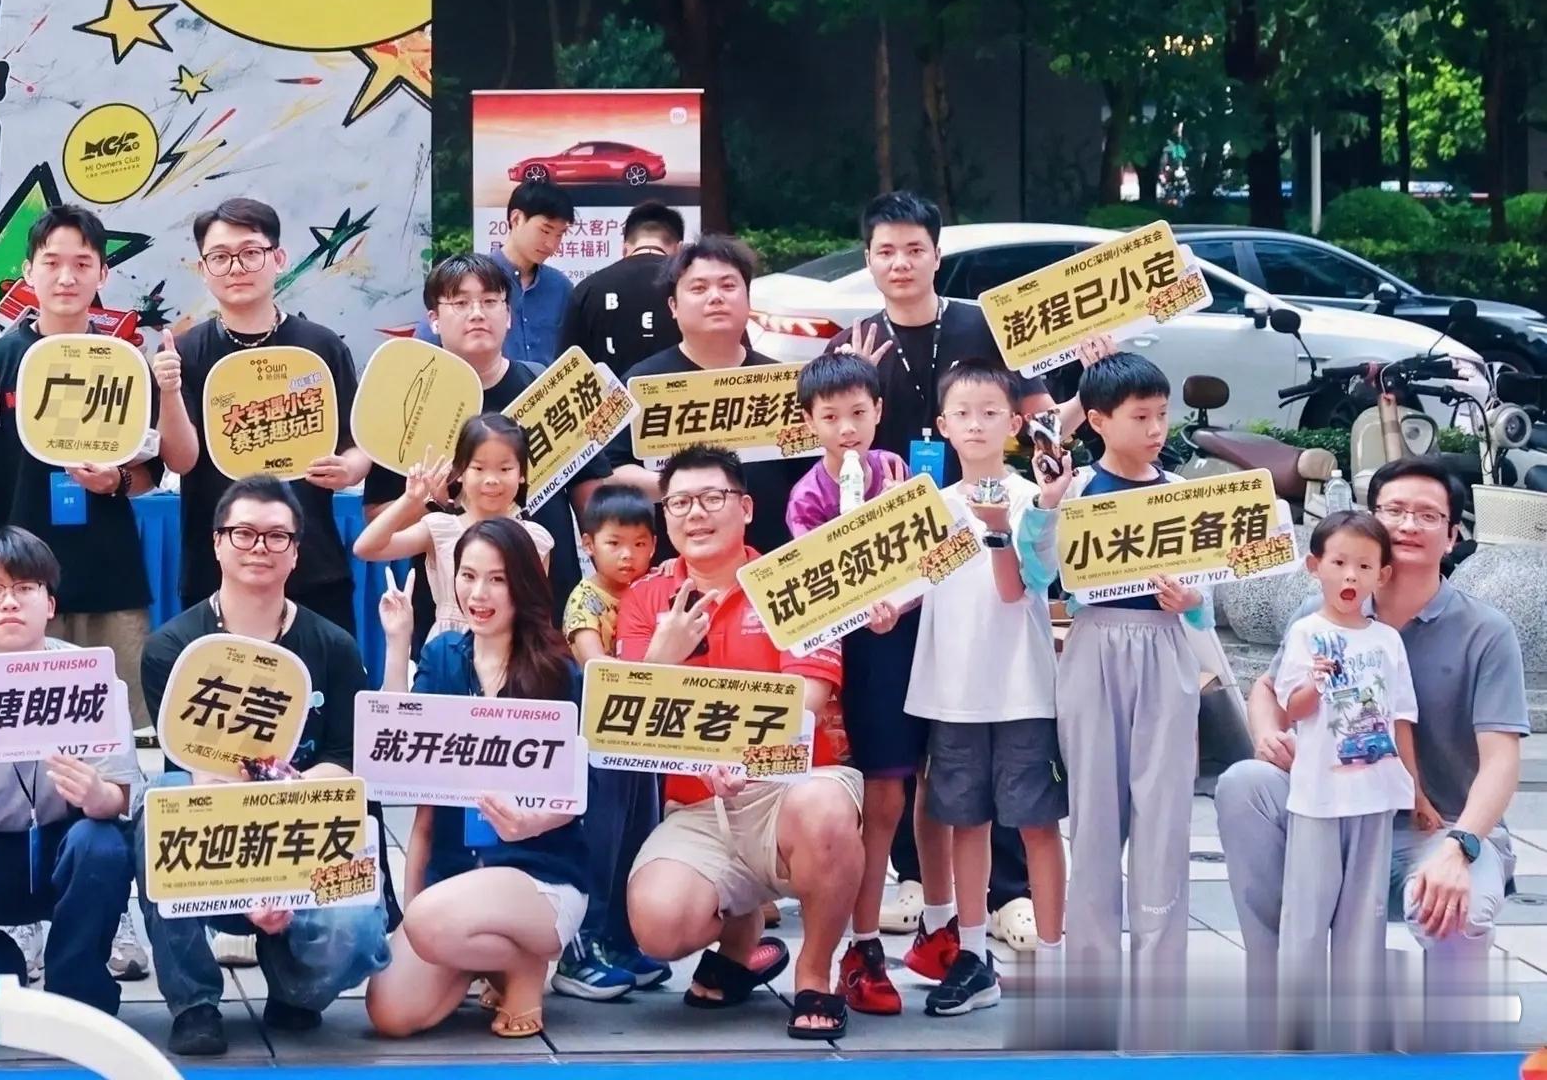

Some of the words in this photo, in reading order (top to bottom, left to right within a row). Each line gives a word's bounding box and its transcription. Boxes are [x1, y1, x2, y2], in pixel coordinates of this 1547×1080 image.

[1064, 230, 1163, 277] #MOC深圳小米车友会
[1003, 250, 1179, 351] 澎程已小定
[714, 370, 798, 387] #MOC深圳小米车友
[1032, 358, 1053, 373] MOC
[34, 373, 134, 425] 广州
[512, 357, 580, 420] OC深圳小米车友会
[222, 388, 324, 437] 大车遇小车
[639, 392, 806, 439] 自在即澎程
[46, 439, 120, 452] 大湾区小米车友会
[230, 410, 324, 455] 赛车趣玩日
[544, 478, 561, 497] MOC
[562, 462, 578, 479] SU7
[580, 443, 596, 461] YU7
[1147, 478, 1262, 506] #MOC深圳小米车友会
[827, 484, 928, 543] #MOC深圳小米车友会
[917, 526, 974, 576] 大车遇小车
[1065, 503, 1271, 571] 小米后备箱
[1226, 533, 1294, 566] 大车遇小车
[766, 506, 948, 626] 试驾领好礼
[1089, 583, 1145, 600] SHENZHEN
[1179, 575, 1199, 586] SU7
[1207, 570, 1229, 582] YU7
[803, 634, 825, 651] MOC
[832, 611, 870, 637] SKYNO
[6, 661, 39, 674] GRAN
[42, 658, 97, 671] TURISMO
[682, 677, 798, 695] #MOC深圳小米车友会
[180, 676, 293, 743] 东莞
[470, 707, 504, 719] GRAN
[506, 709, 561, 721] TURISMO
[596, 694, 789, 745] 四驱老子
[57, 743, 89, 757] YU7
[92, 742, 122, 753] GT
[182, 742, 250, 764] 大湾区小米车
[370, 728, 565, 769] 就开纯血GT
[603, 756, 659, 769] SHENZHEN
[660, 760, 684, 771] MOC
[743, 744, 810, 765] 大车遇小车
[242, 788, 356, 807] #MOC深圳小米车友会
[515, 795, 546, 809] YU7
[548, 799, 578, 811] GT
[155, 816, 361, 873] 欢迎新车友
[310, 857, 376, 891] 大车遇小车
[172, 898, 228, 914] SHENZHEN
[229, 898, 254, 909] MOC
[290, 894, 311, 906] YU7
